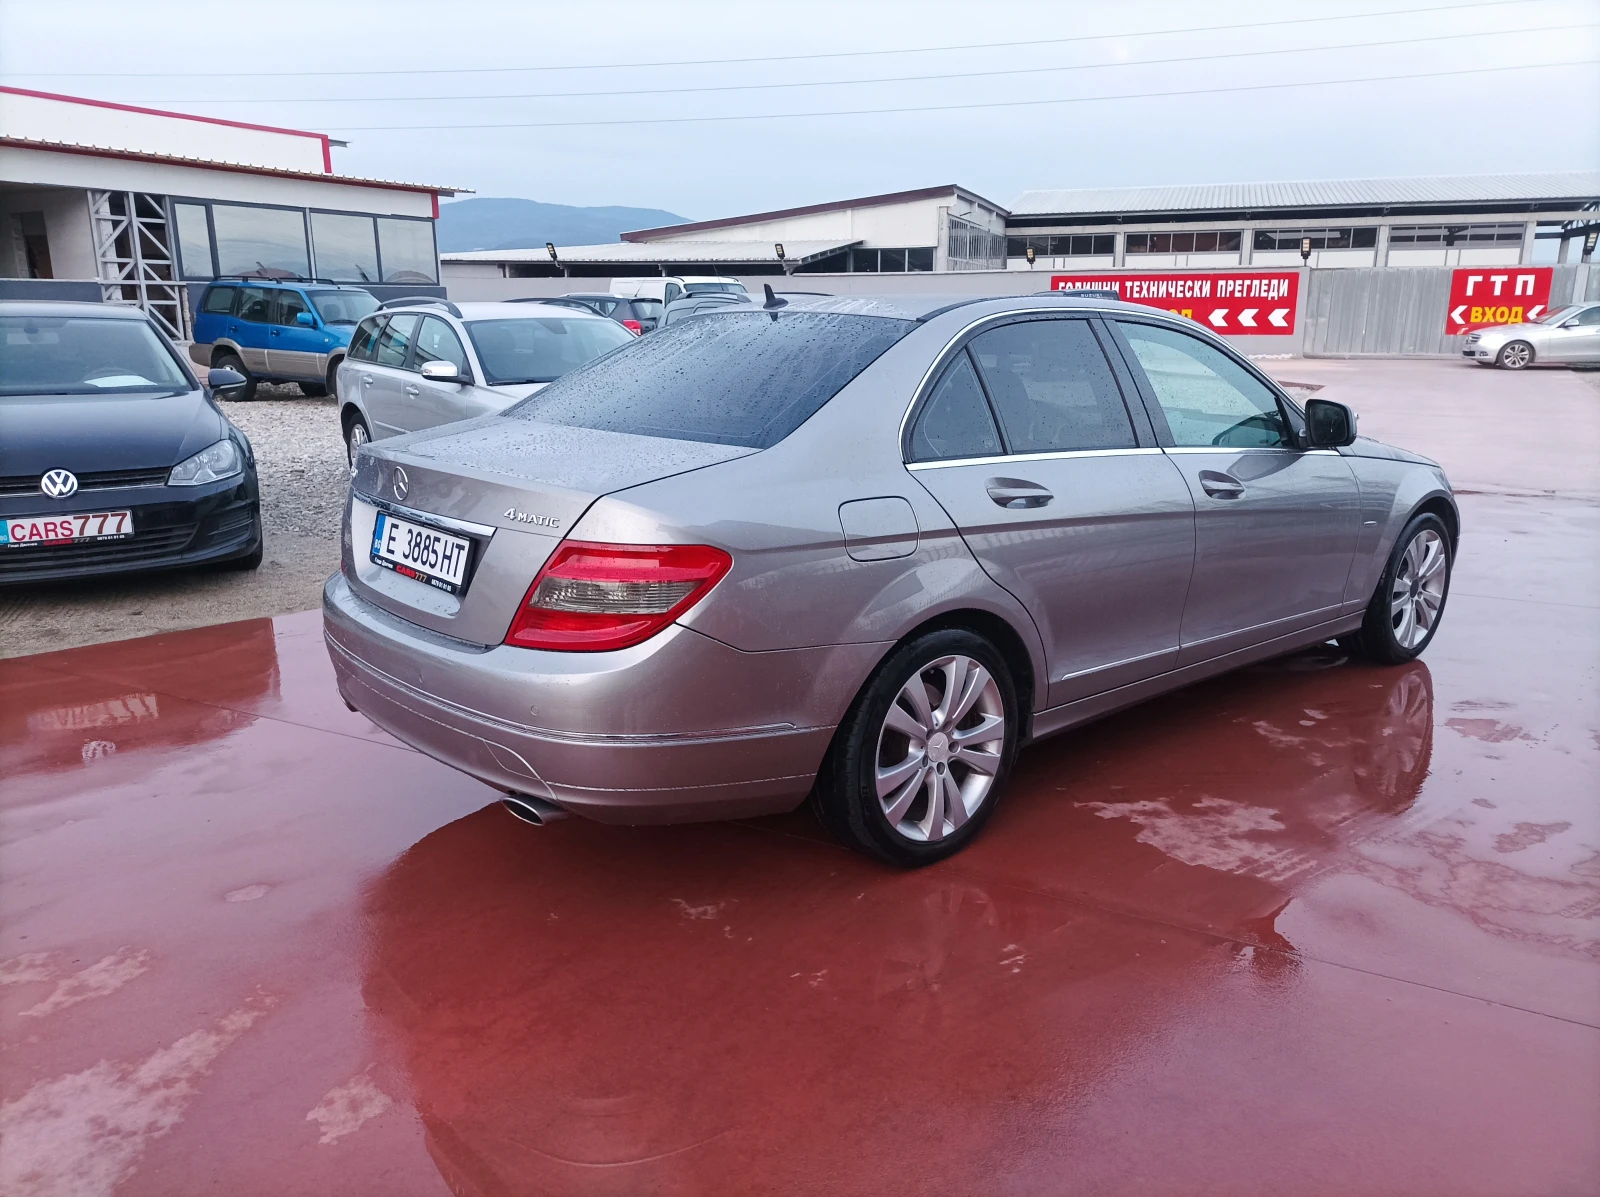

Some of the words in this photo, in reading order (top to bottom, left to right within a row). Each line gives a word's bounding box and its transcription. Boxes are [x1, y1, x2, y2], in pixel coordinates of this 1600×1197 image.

[1125, 280, 1211, 298] ТЕХНИЧЕСКИ
[1216, 279, 1289, 300] ПРЕГЛЕДИ
[1470, 306, 1523, 324] ВХОД
[386, 522, 399, 555] E
